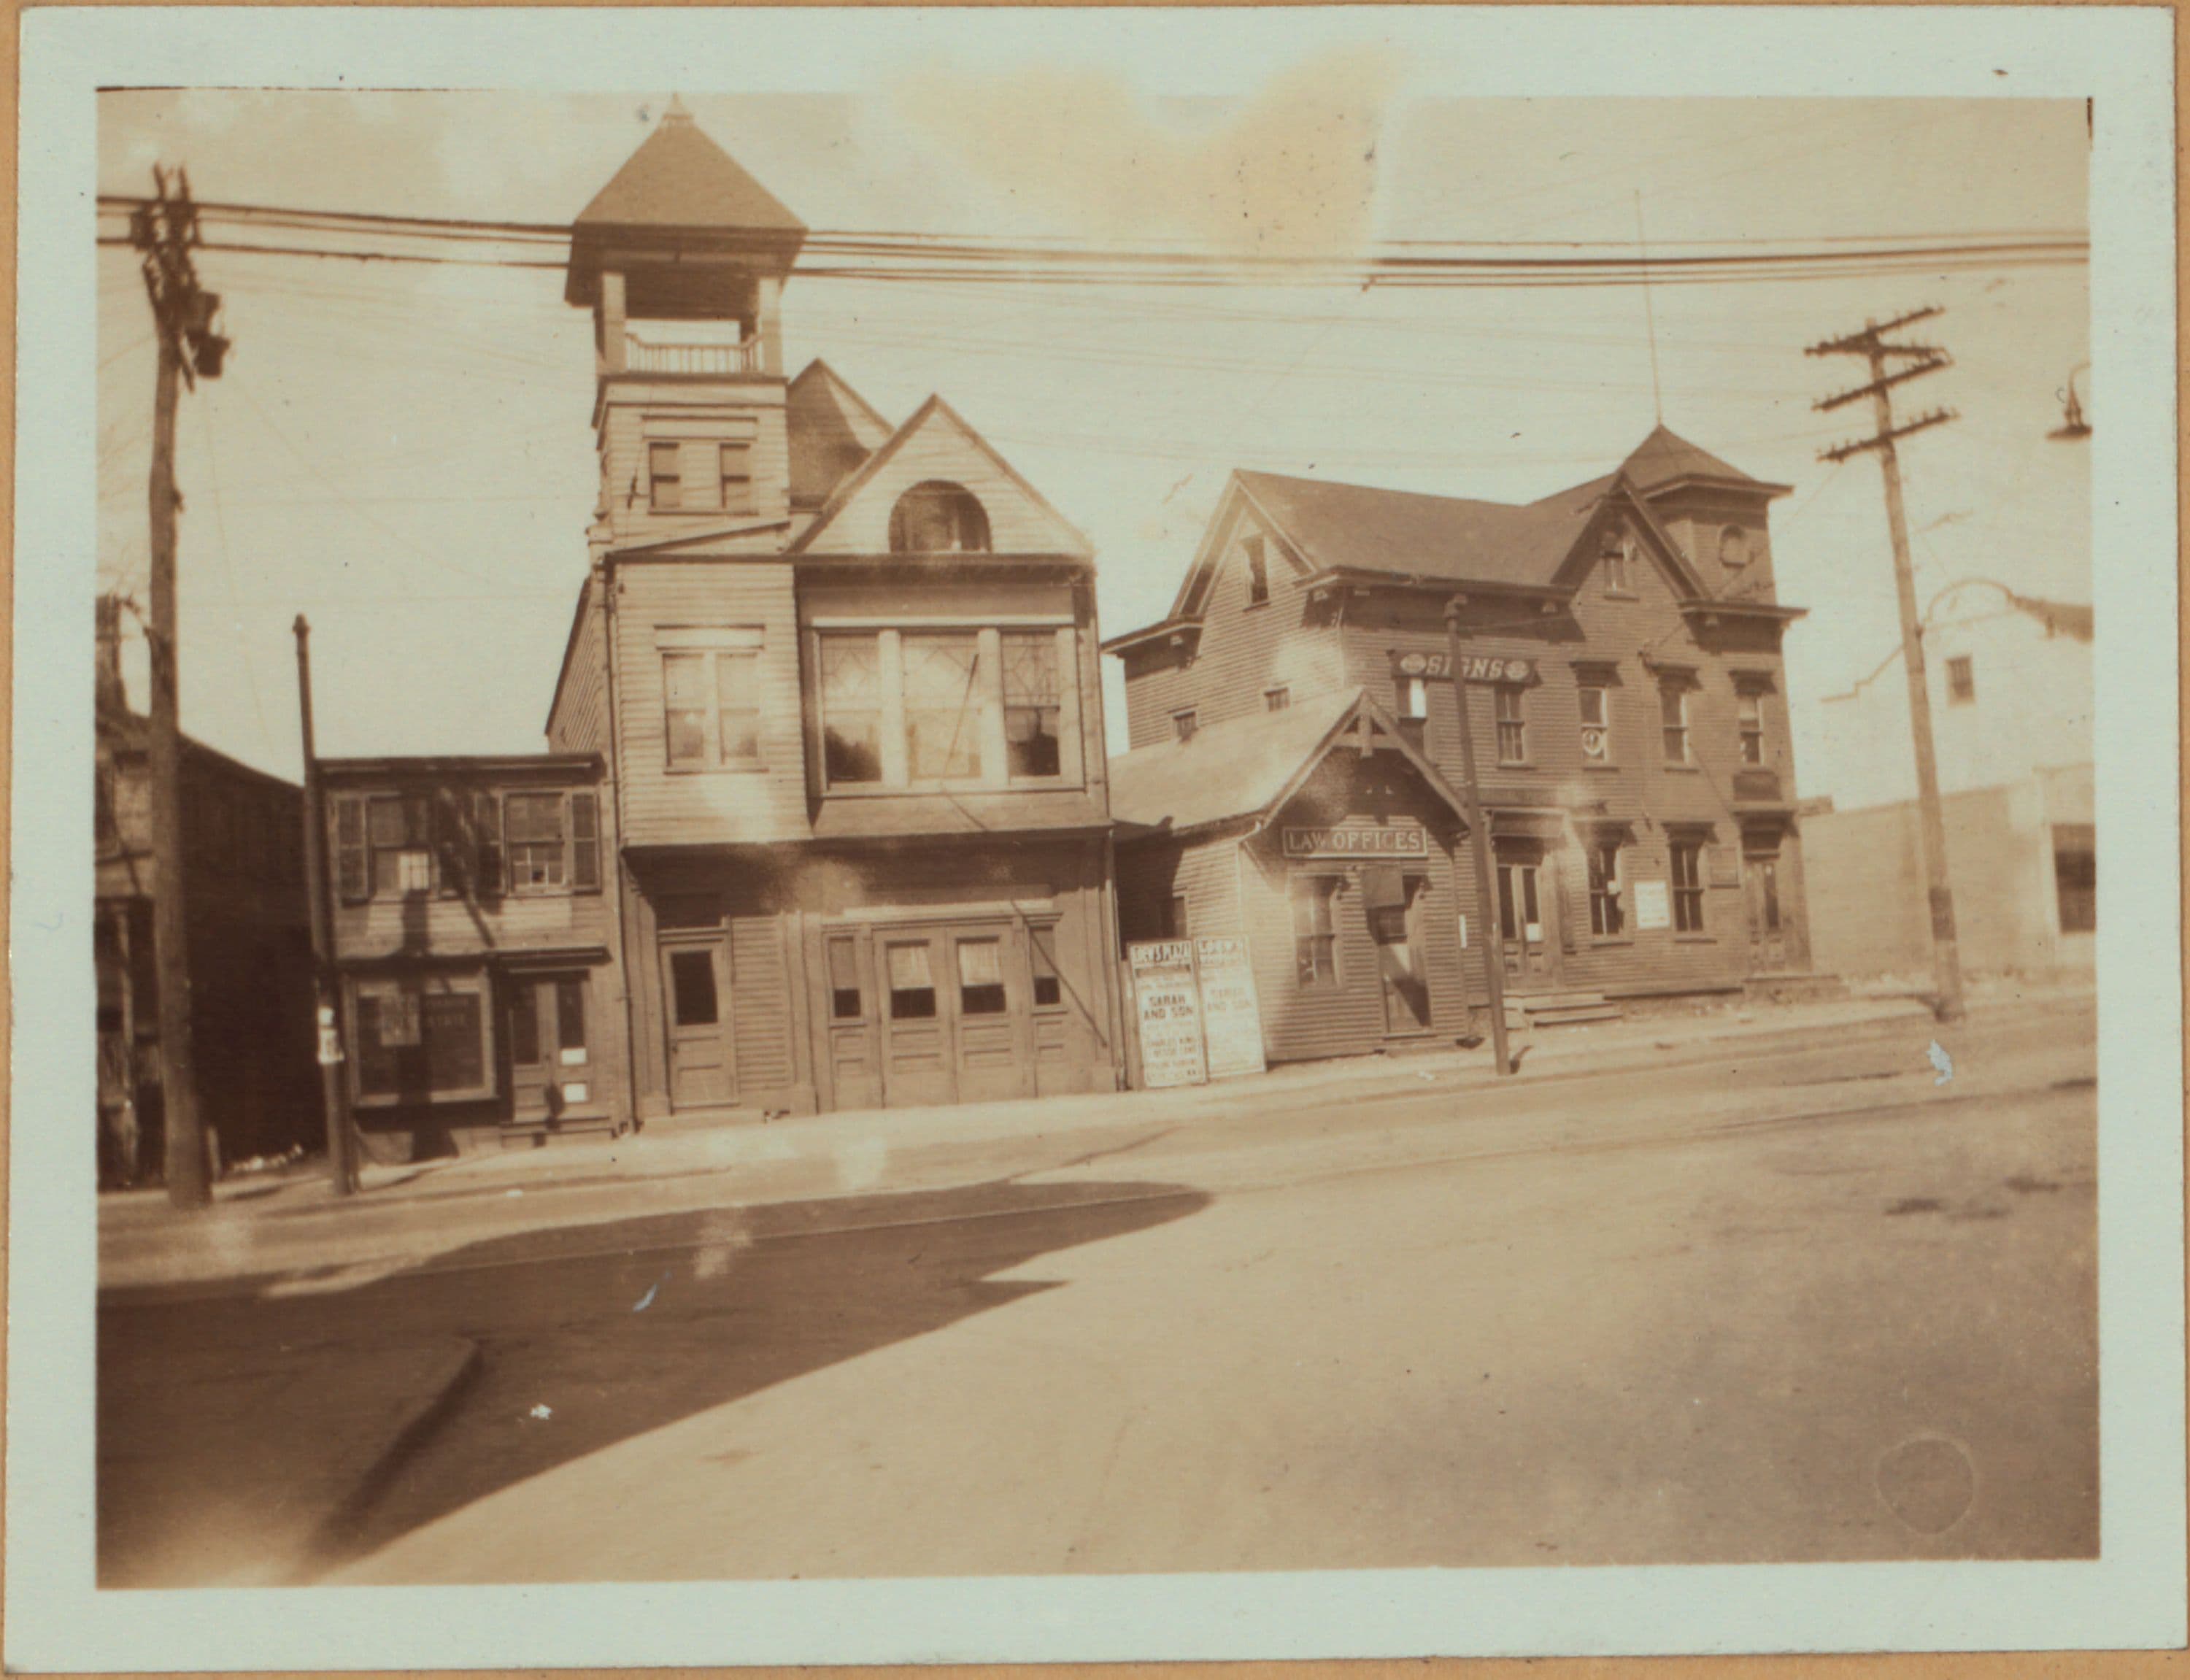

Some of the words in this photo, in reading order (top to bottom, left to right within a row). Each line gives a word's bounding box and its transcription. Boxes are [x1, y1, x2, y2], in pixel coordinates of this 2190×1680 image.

[1425, 655, 1505, 681] SIGNS
[1289, 831, 1326, 851] LAW
[1333, 831, 1421, 851] OFFICES
[1149, 994, 1186, 1007] SARAH
[1144, 1007, 1166, 1021] AND
[1170, 1006, 1193, 1018] SON
